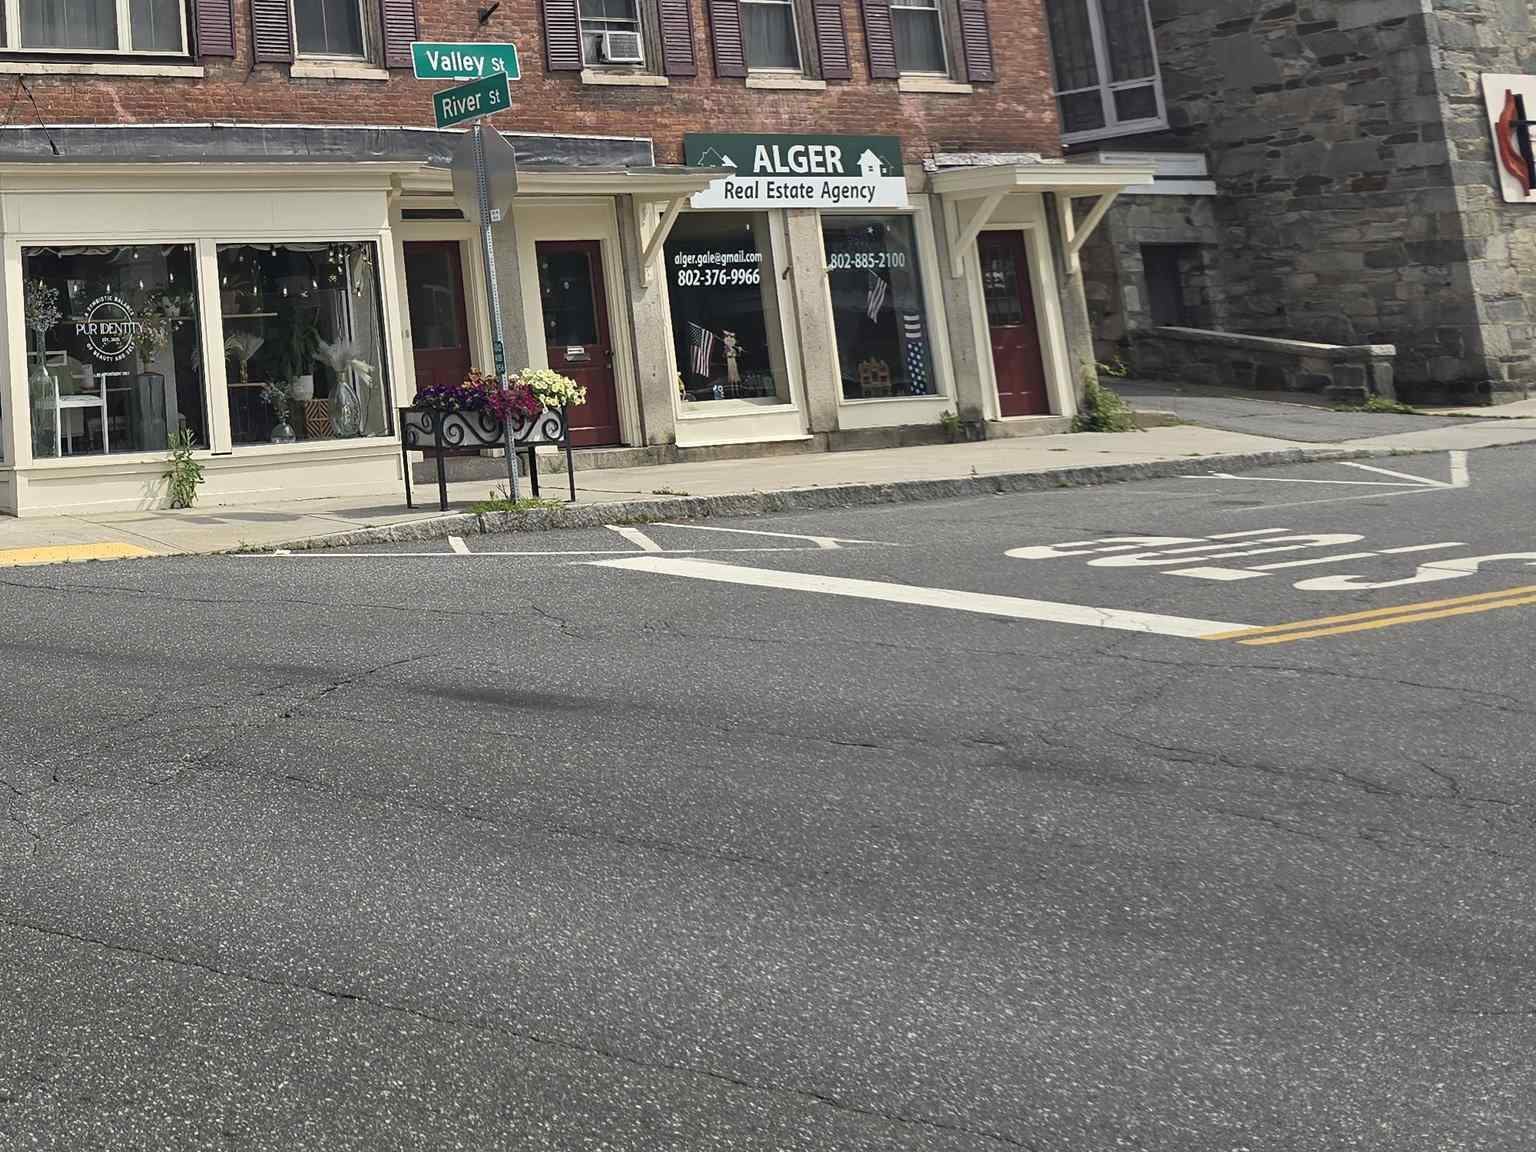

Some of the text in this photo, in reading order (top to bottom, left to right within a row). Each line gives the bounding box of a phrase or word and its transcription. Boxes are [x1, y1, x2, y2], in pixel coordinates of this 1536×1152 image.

[426, 51, 505, 76] Valley St
[442, 89, 501, 119] River St
[753, 144, 844, 174] ALGER
[724, 180, 876, 203] Real Estate Agency
[674, 250, 762, 267] alger.gale@gmail.com
[830, 252, 905, 269] 802-885-2100
[677, 268, 760, 286] 802-376-9966
[75, 322, 144, 336] PUR IDENTITY
[93, 350, 114, 362] BEAUTY
